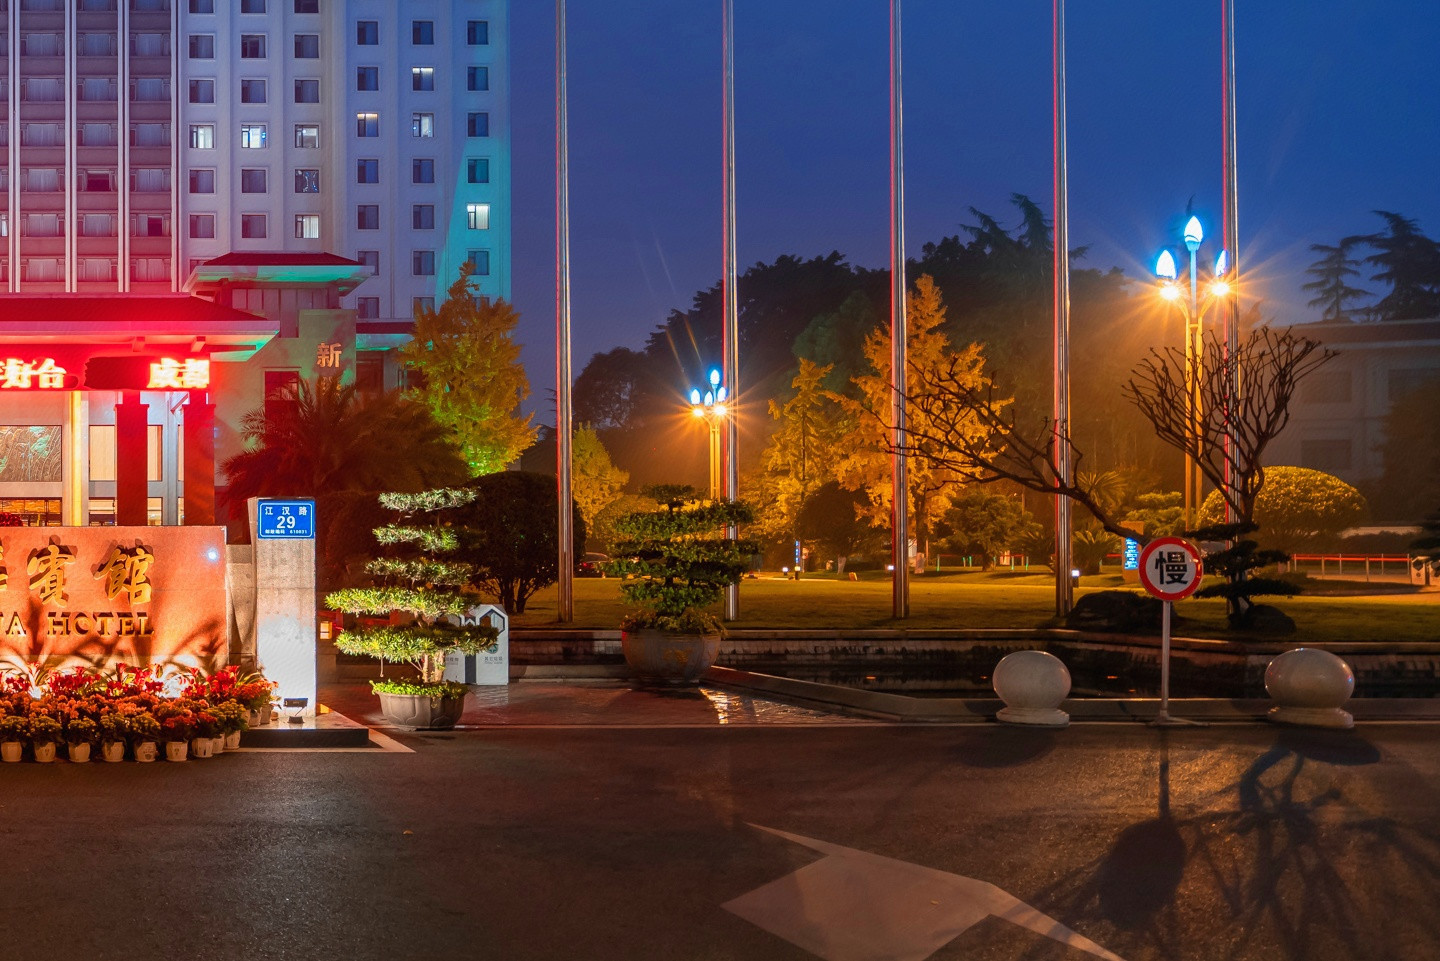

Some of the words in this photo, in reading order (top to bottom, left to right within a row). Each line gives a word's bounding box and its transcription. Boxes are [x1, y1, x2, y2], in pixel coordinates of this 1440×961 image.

[264, 506, 308, 516] 江汉路
[276, 515, 296, 529] 29
[1154, 550, 1189, 585] 慢
[47, 612, 155, 638] HOTEL
